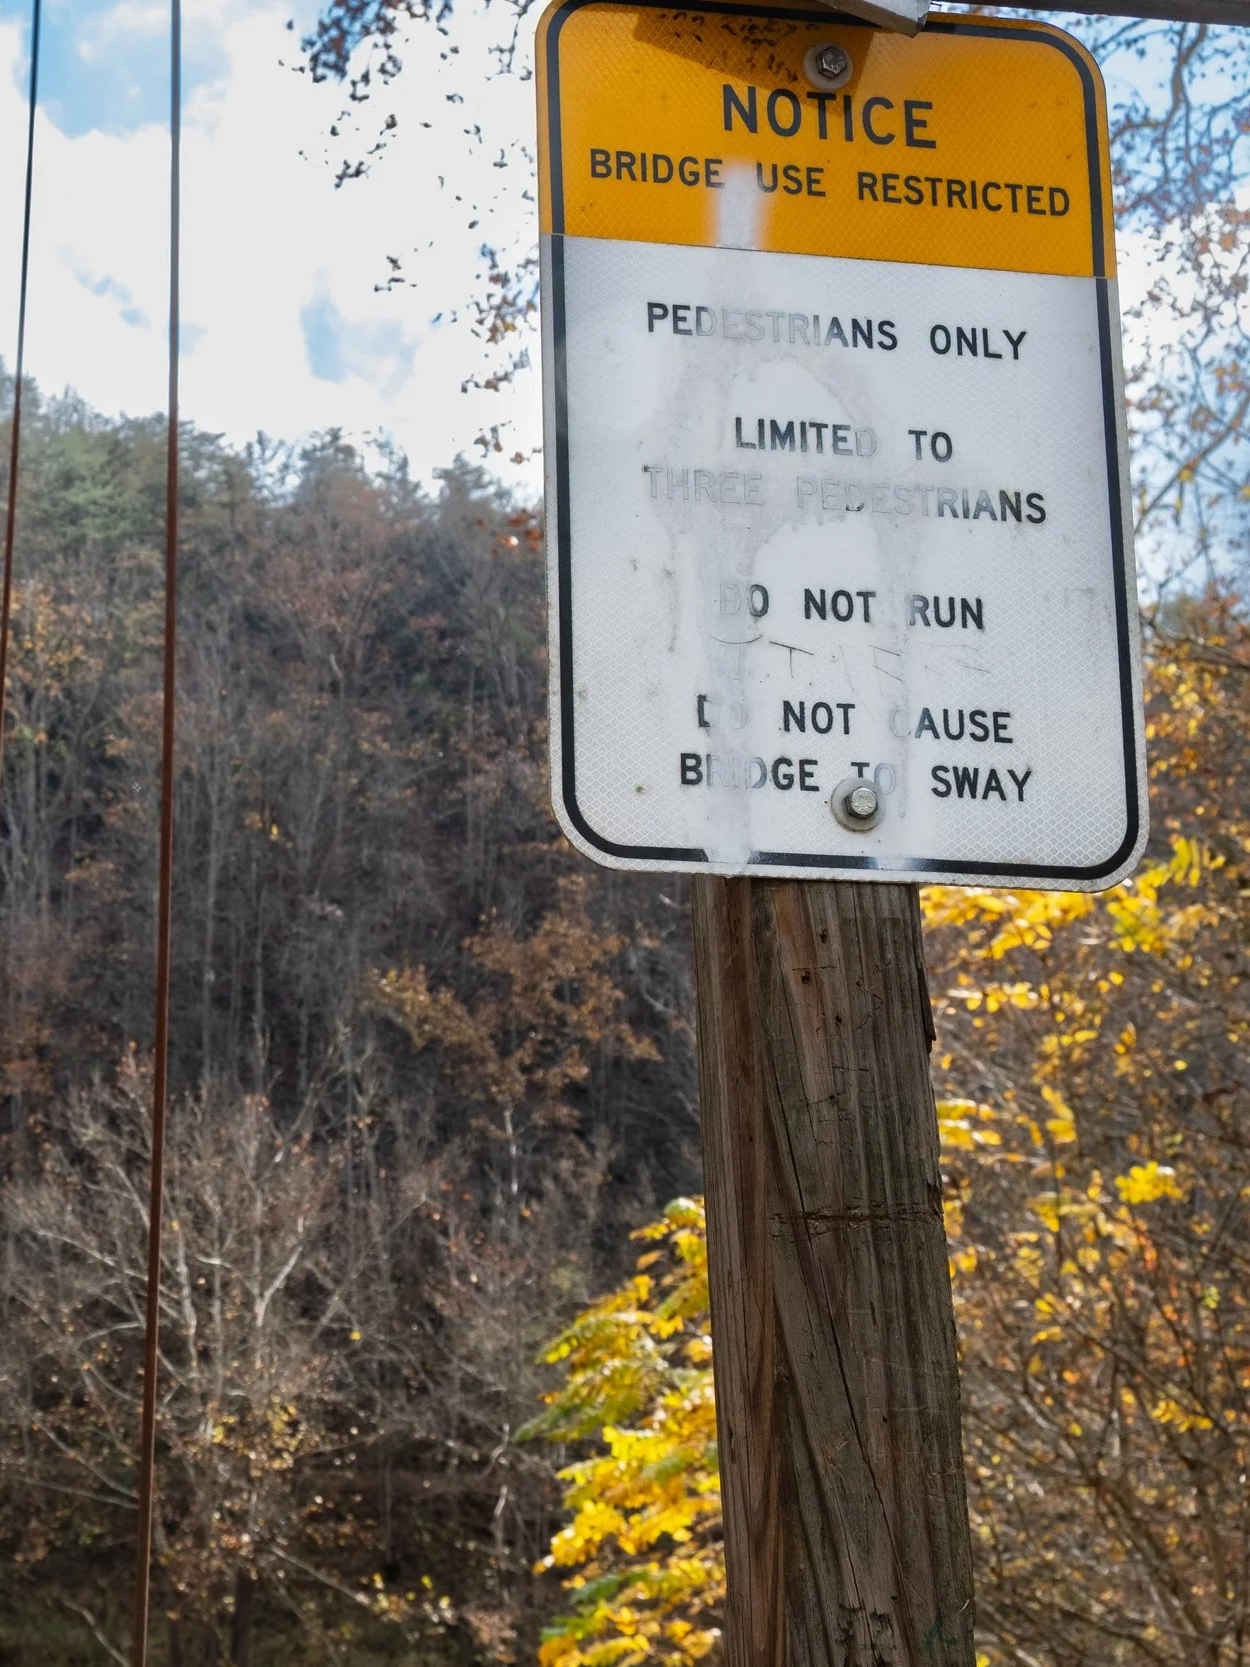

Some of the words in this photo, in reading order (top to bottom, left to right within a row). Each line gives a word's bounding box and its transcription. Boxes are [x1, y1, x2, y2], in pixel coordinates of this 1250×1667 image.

[722, 84, 937, 149] NOTICE
[590, 148, 725, 189] BRIDGE
[756, 162, 827, 197] USE
[857, 172, 1070, 217] RESTRICTED
[647, 301, 899, 352] PEDESTRIANS
[930, 324, 1028, 360] ONLY
[734, 416, 878, 458] LIMITED
[908, 429, 954, 463] TO
[643, 465, 765, 505] THREE
[795, 475, 1047, 524] PEDESTRIANS
[804, 588, 876, 622] NOT
[909, 594, 984, 629] RUN
[782, 700, 856, 735] NOT
[931, 765, 1033, 802] SWAY
